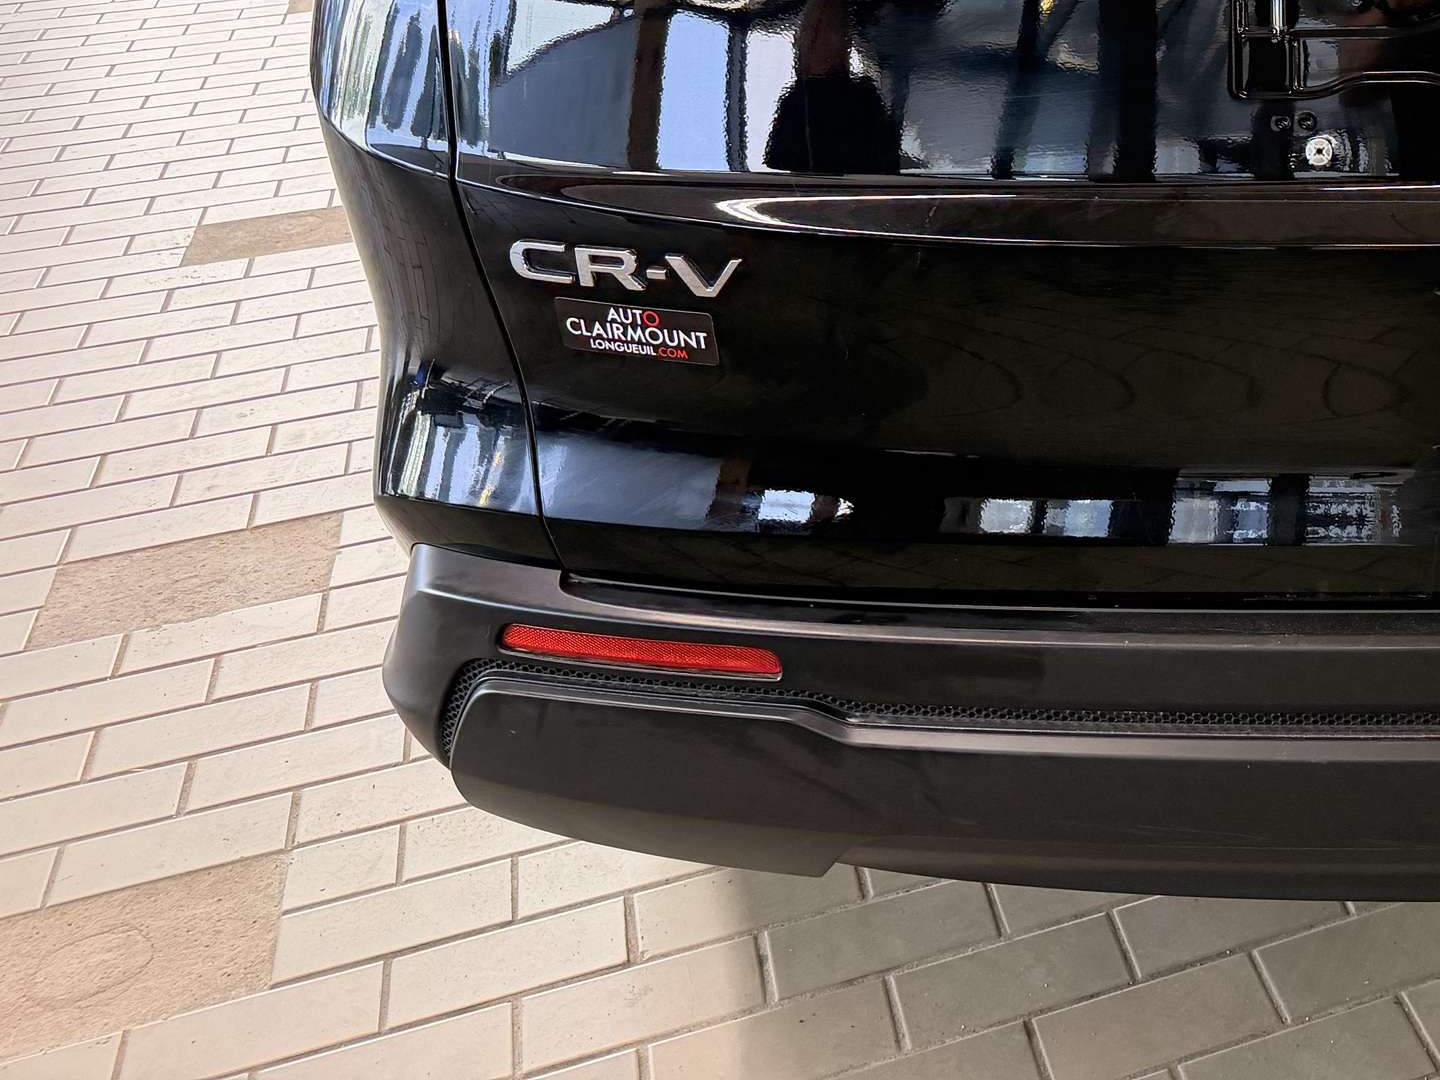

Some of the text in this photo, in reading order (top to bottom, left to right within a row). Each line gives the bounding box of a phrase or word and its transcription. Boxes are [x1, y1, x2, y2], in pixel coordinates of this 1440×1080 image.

[509, 238, 743, 298] CR-V
[607, 307, 661, 328] AUTO
[566, 317, 708, 350] CLAIRMOUNT
[589, 338, 689, 360] LONGUEUIL.COM
